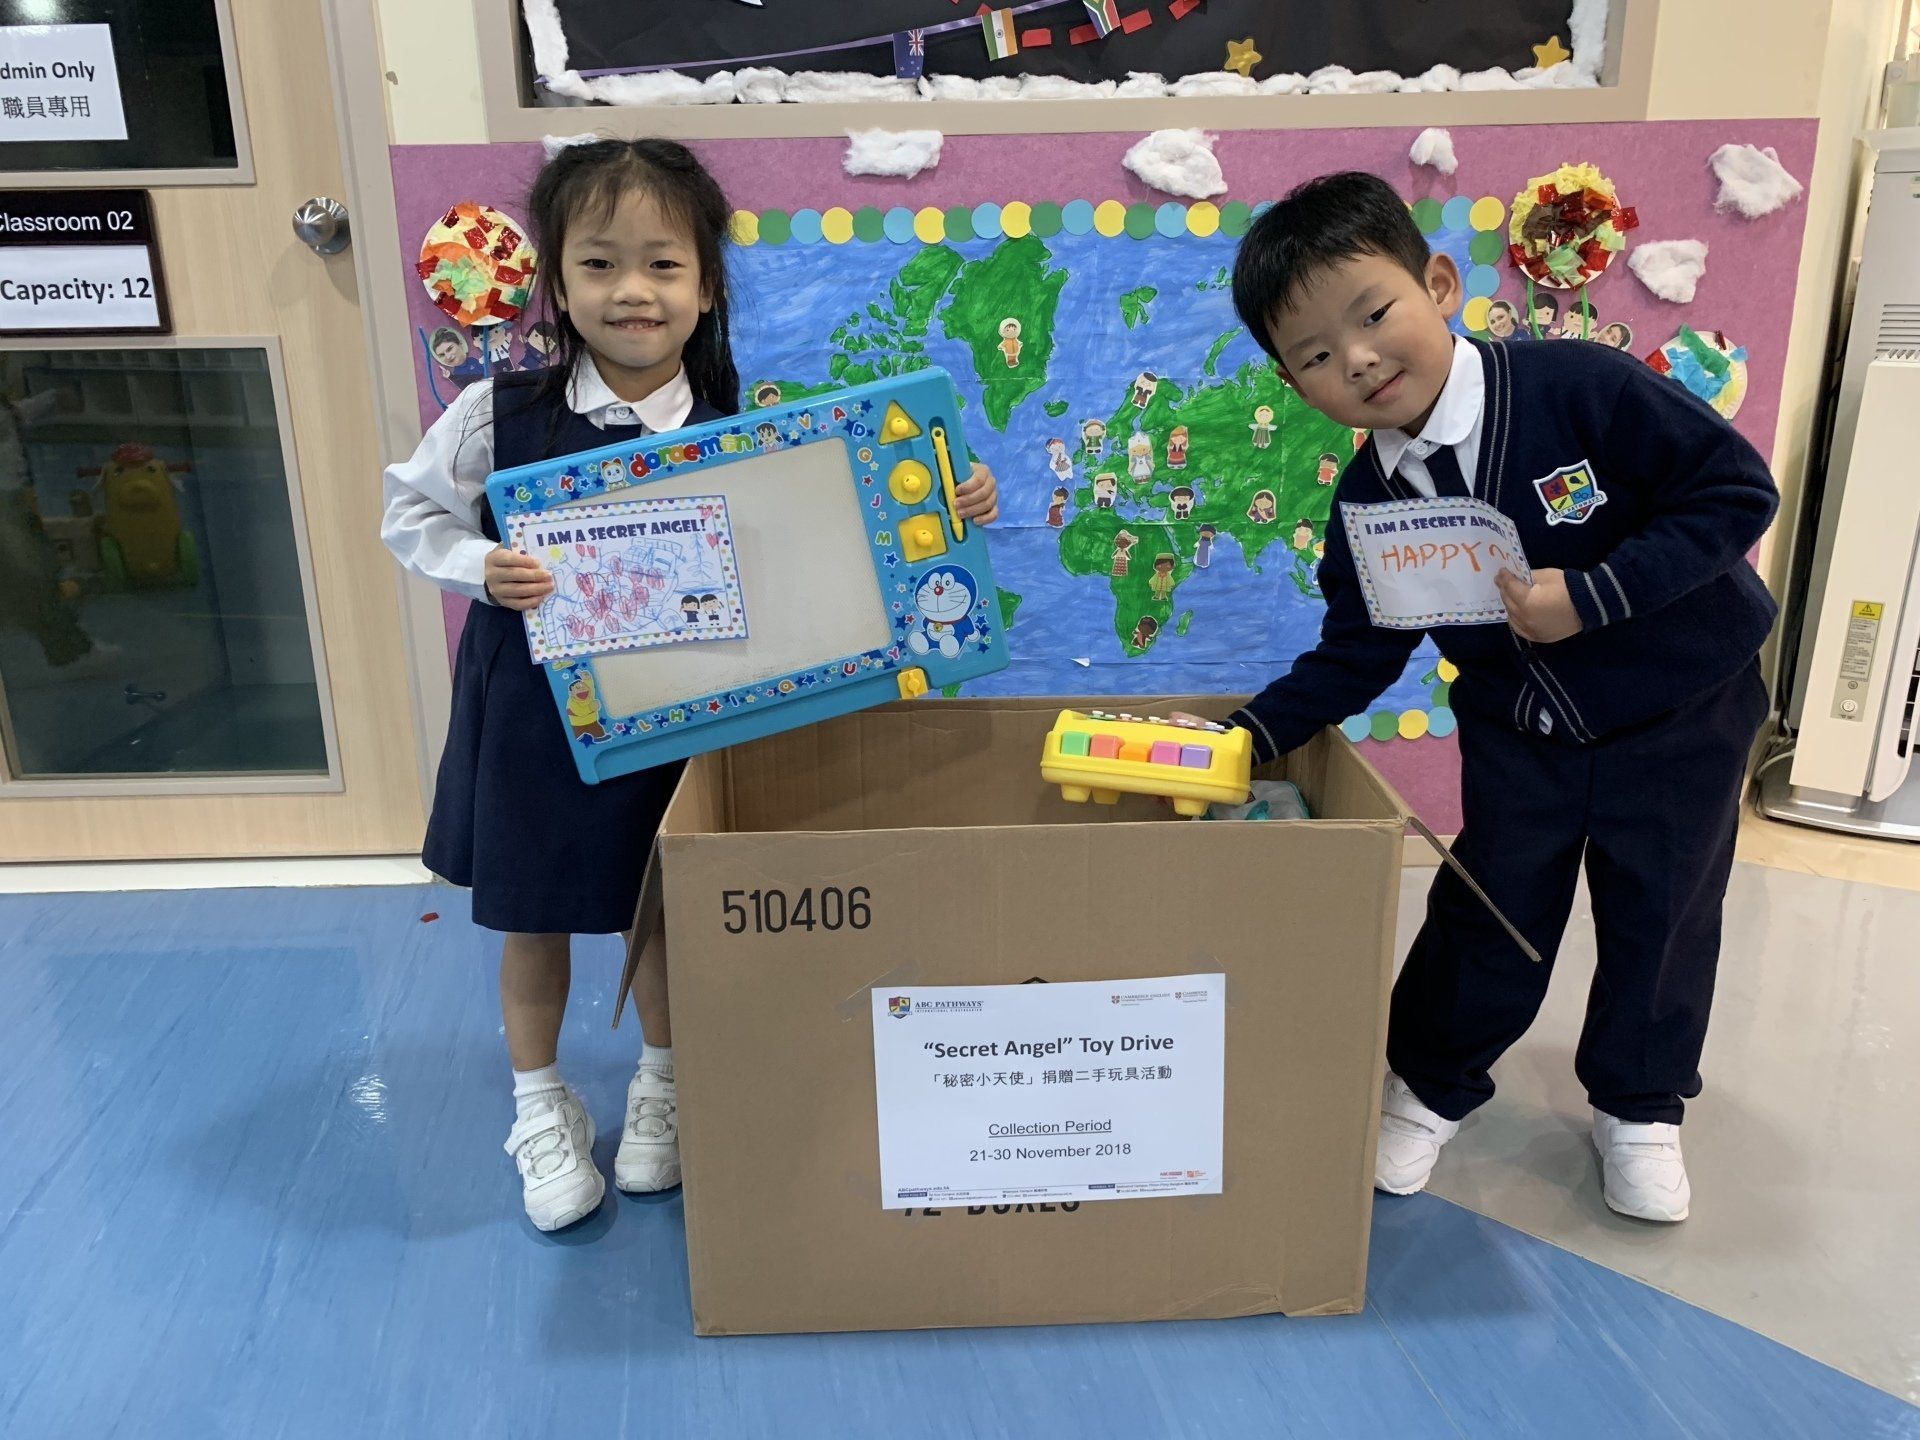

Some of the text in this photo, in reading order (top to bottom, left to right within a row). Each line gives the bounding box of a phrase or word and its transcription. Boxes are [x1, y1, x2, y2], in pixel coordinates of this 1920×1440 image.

[52, 61, 95, 82] Only
[1, 96, 91, 119] 職員專用
[107, 211, 134, 230] 02
[0, 277, 152, 305] Capacity: 12
[832, 406, 847, 422] A
[852, 422, 866, 438] D
[629, 433, 755, 478] doraemon
[559, 475, 574, 492] K
[871, 493, 881, 508] J
[536, 518, 707, 547] I AM A SECRET ANGEL!
[1365, 523, 1371, 535] I
[1374, 521, 1397, 535] AM
[1400, 520, 1411, 532] A
[1411, 515, 1467, 531] SECRET
[875, 531, 892, 546] M
[1381, 541, 1482, 572] HAPPY
[669, 709, 684, 723] H
[843, 661, 857, 676] U
[722, 886, 871, 934] 510406
[924, 1035, 1174, 1058] “Secret Angel” Toy Drive
[988, 1119, 1112, 1136] Collection Period
[970, 1143, 1131, 1161] 21-30 November 2018
